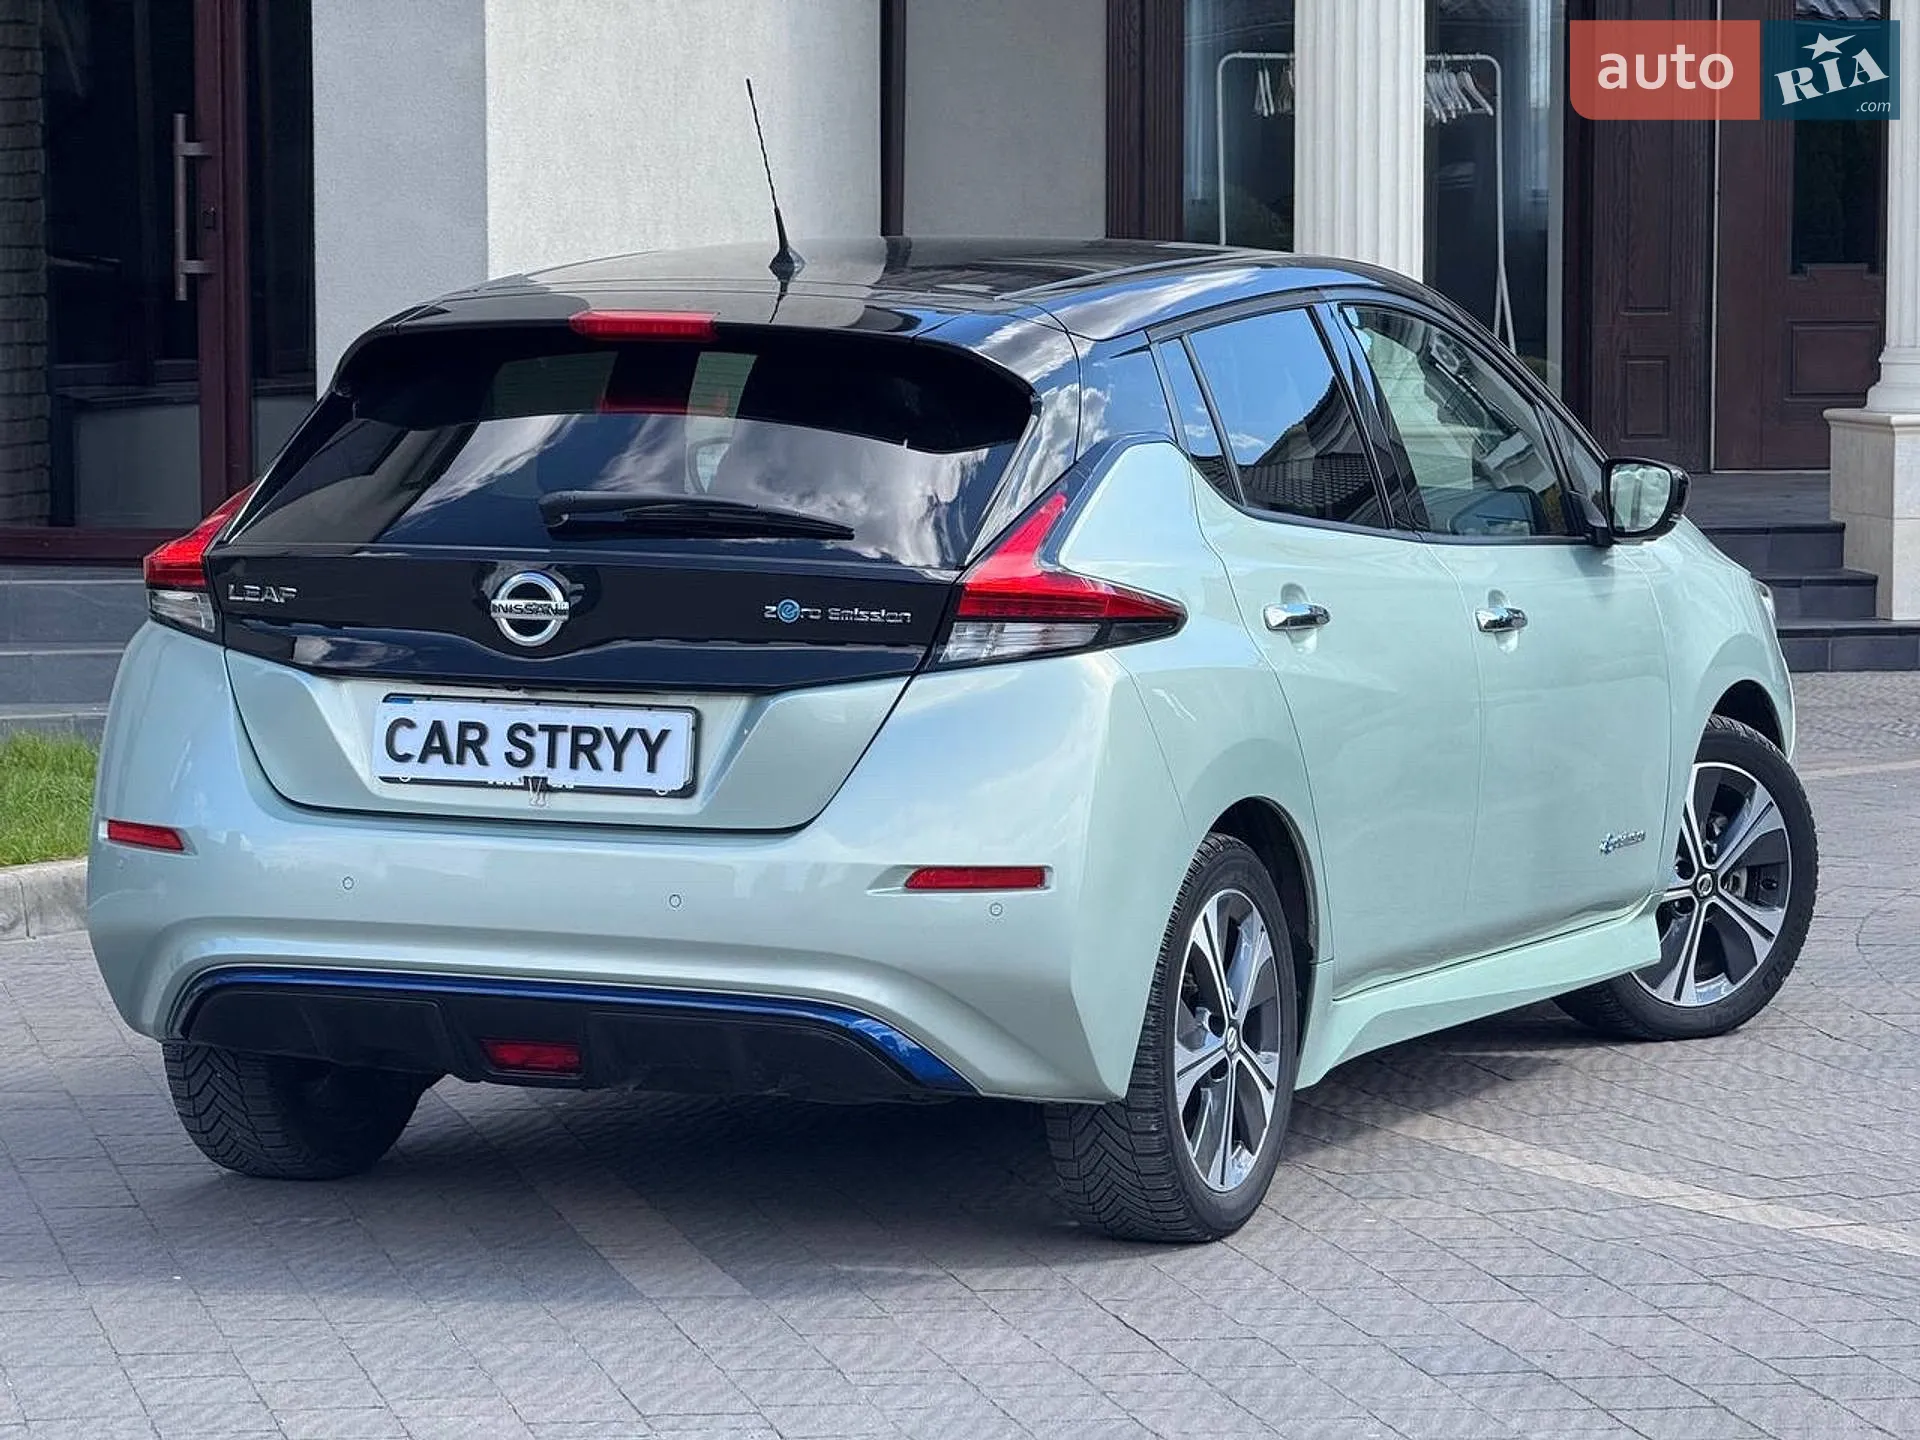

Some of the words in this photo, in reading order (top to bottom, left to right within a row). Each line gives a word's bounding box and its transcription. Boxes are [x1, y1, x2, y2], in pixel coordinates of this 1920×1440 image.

[228, 584, 298, 603] LEAF
[497, 603, 559, 616] NISSAN
[828, 607, 912, 623] Emission
[385, 717, 490, 767] CAR
[504, 722, 671, 774] STRYY
